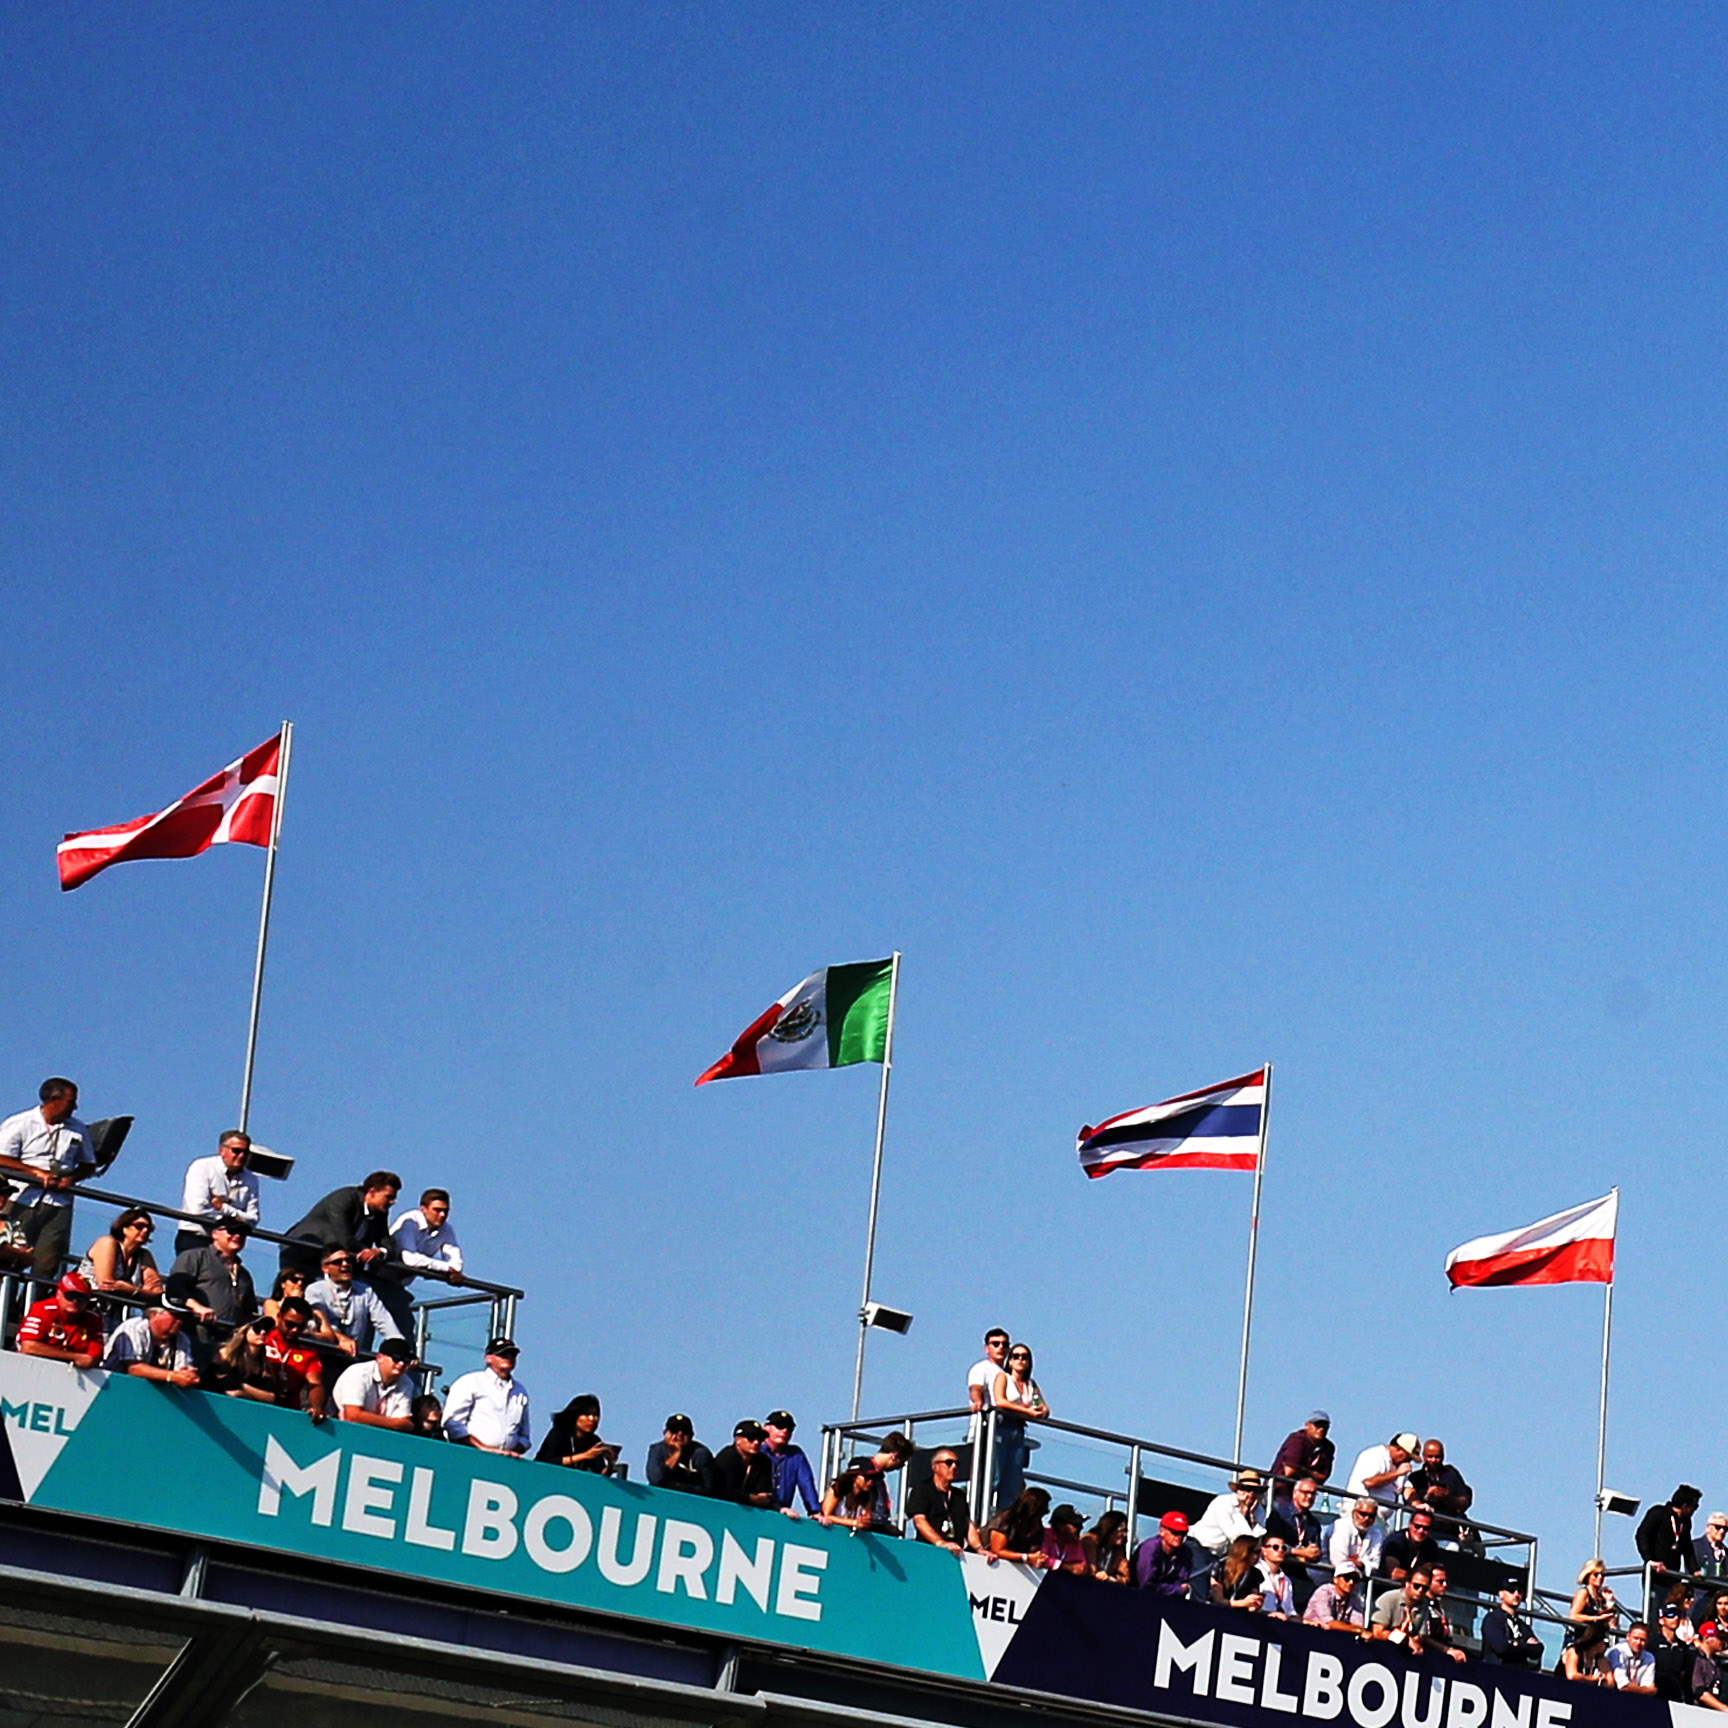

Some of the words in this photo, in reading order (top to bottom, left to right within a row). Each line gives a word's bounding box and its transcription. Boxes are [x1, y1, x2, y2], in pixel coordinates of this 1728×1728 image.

[0, 1396, 76, 1437] MEL
[256, 1433, 829, 1622] MELBOURNE
[969, 1591, 1022, 1624] MEL
